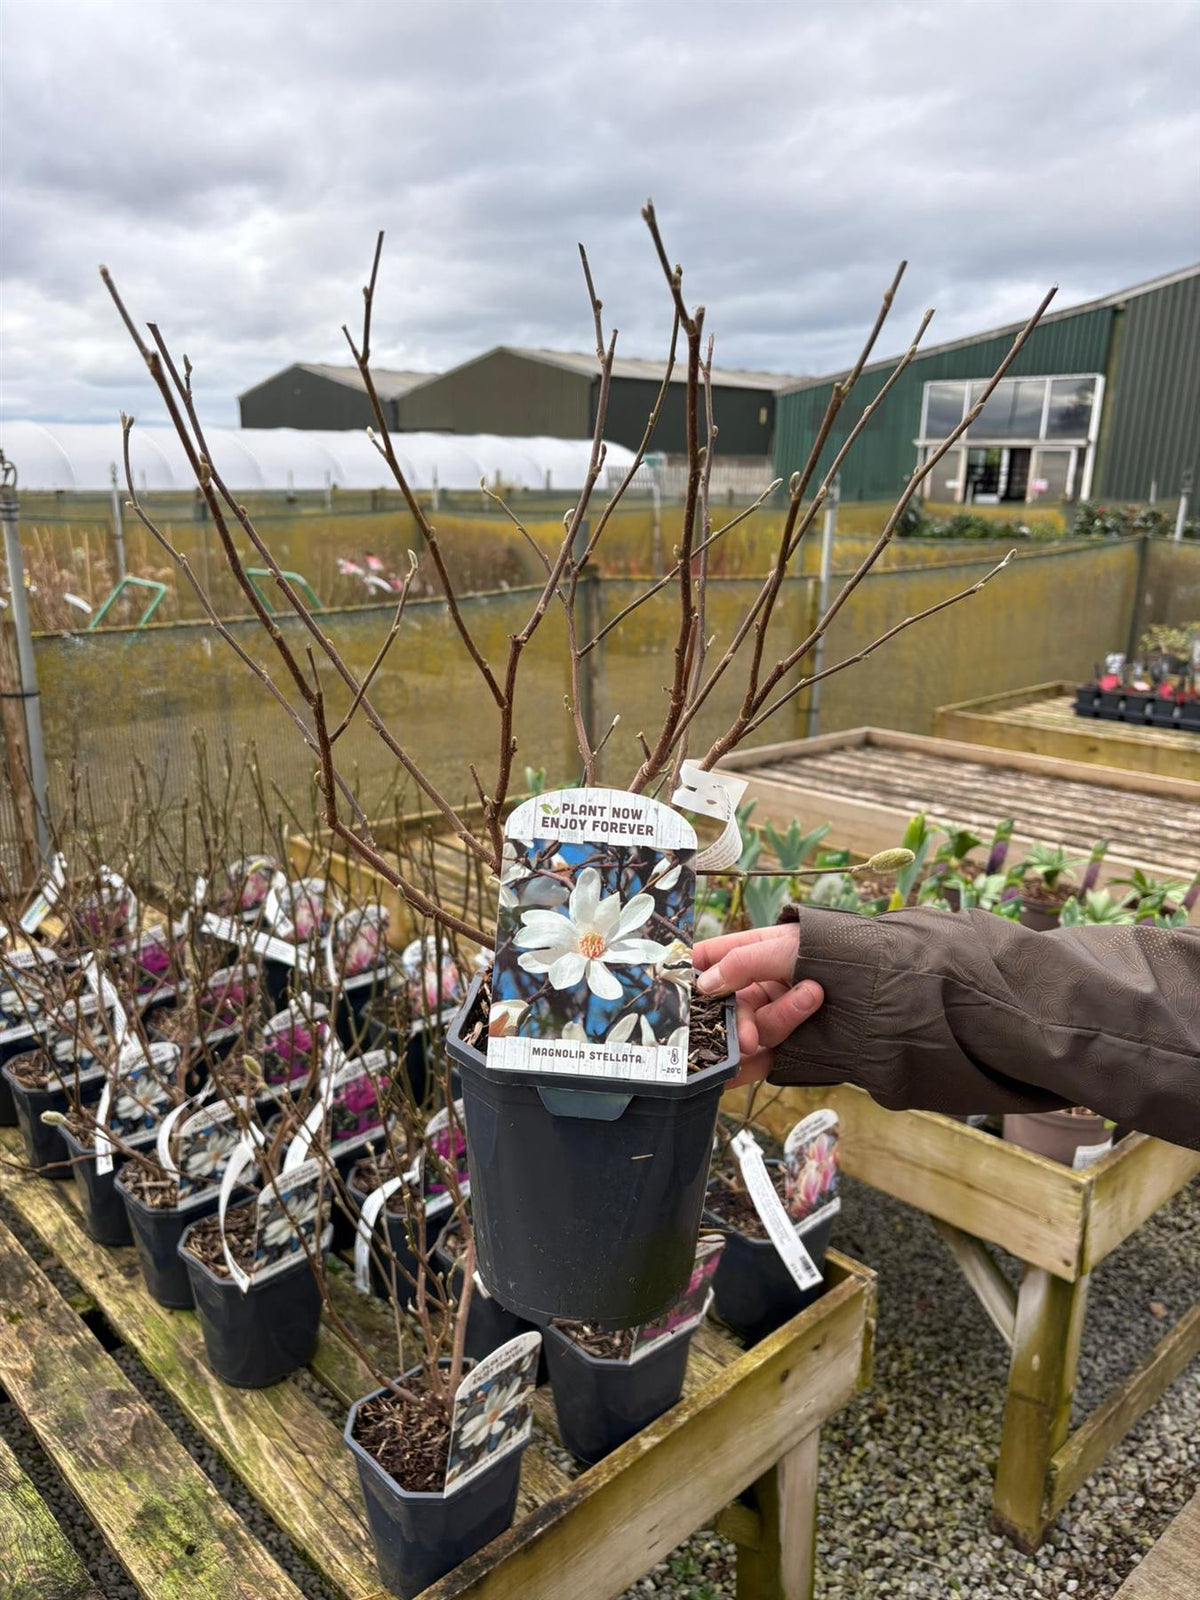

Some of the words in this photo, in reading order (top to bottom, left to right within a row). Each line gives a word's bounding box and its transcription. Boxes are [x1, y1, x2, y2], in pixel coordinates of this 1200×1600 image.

[561, 802, 607, 817] PLANT
[611, 806, 643, 820] NOW
[541, 816, 587, 830] ENJOY
[592, 820, 654, 836] FOREVER
[532, 1047, 585, 1059] MAGNOLIA
[589, 1052, 642, 1064] STELLATA
